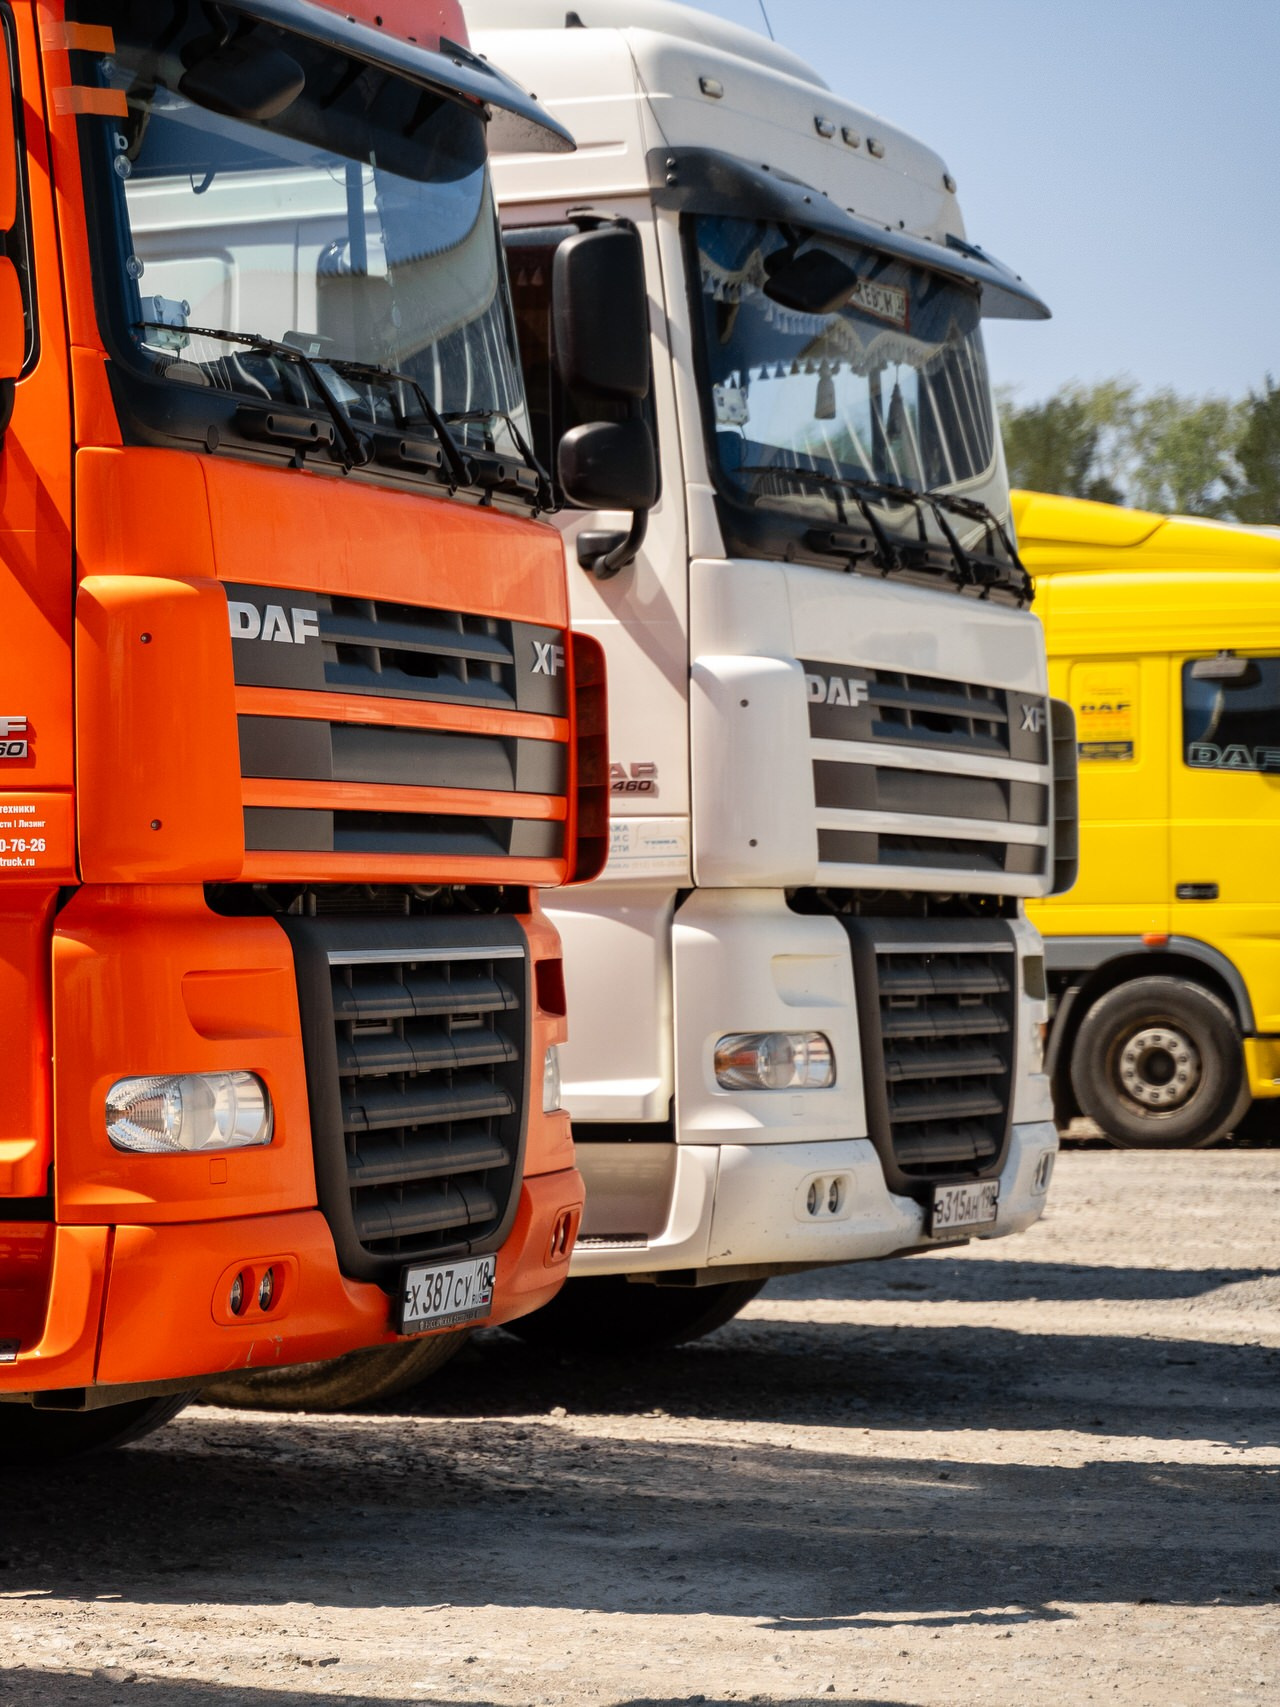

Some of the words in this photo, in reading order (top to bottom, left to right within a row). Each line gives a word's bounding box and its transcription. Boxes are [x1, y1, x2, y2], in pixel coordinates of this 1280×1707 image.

[227, 601, 320, 644] DAF
[531, 641, 566, 676] XF
[805, 673, 869, 707] DAF
[1021, 704, 1047, 733] XF
[18, 820, 46, 828] Лизинг
